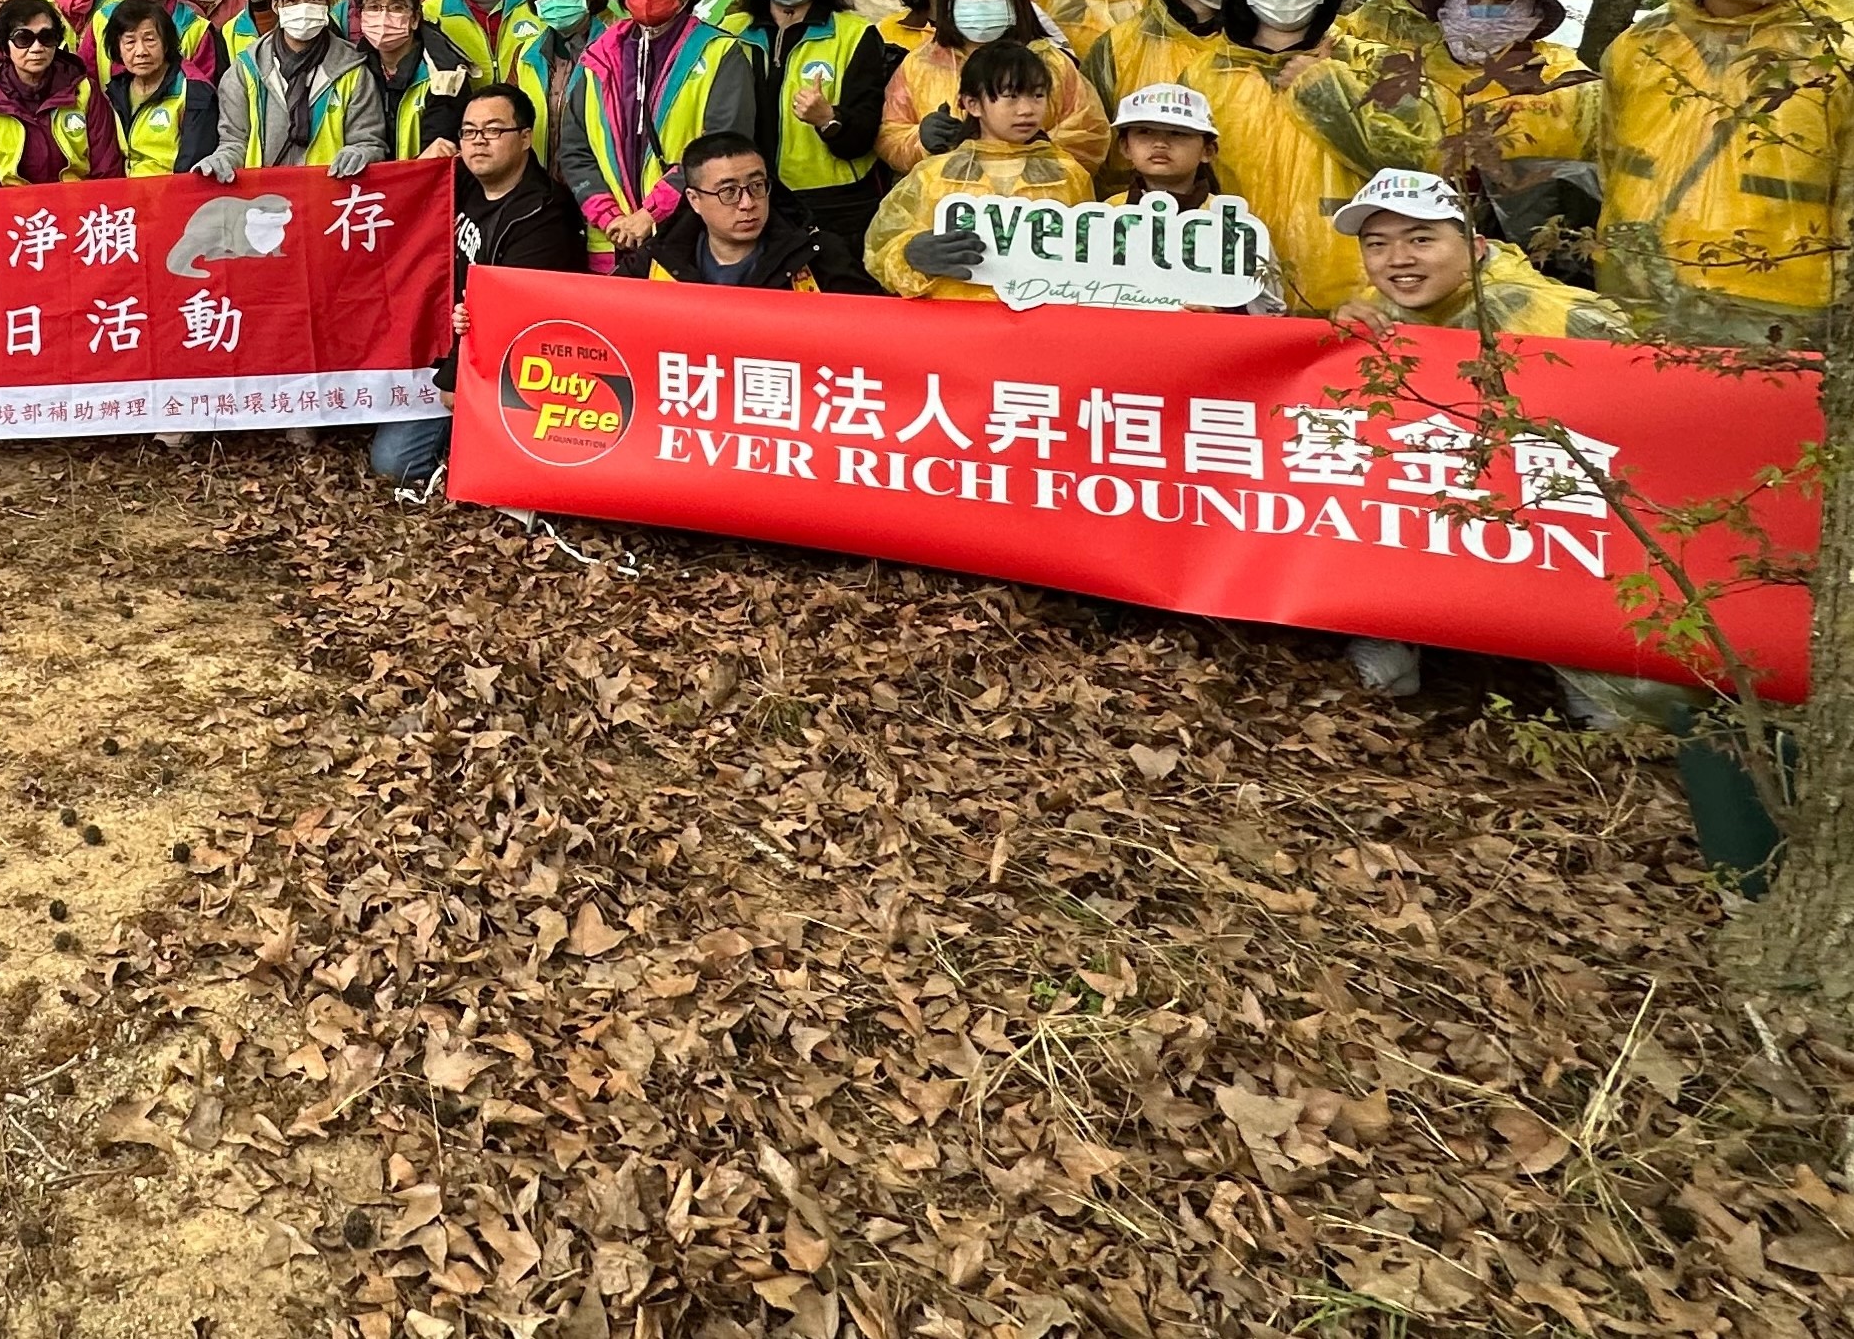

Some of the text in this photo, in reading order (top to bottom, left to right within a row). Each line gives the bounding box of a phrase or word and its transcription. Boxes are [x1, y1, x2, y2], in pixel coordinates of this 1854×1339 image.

[945, 200, 1257, 277] everrich
[541, 343, 608, 362] EVER RICH
[162, 386, 374, 418] 金門縣環境保護局
[390, 383, 440, 407] 廣告
[518, 355, 598, 403] Duty
[533, 402, 621, 440] Free
[547, 434, 607, 449] FOUNDATION
[657, 351, 1621, 520] 財團法人昇恒昌基金會
[655, 424, 1611, 579] EVER RICH FOUNDATION
